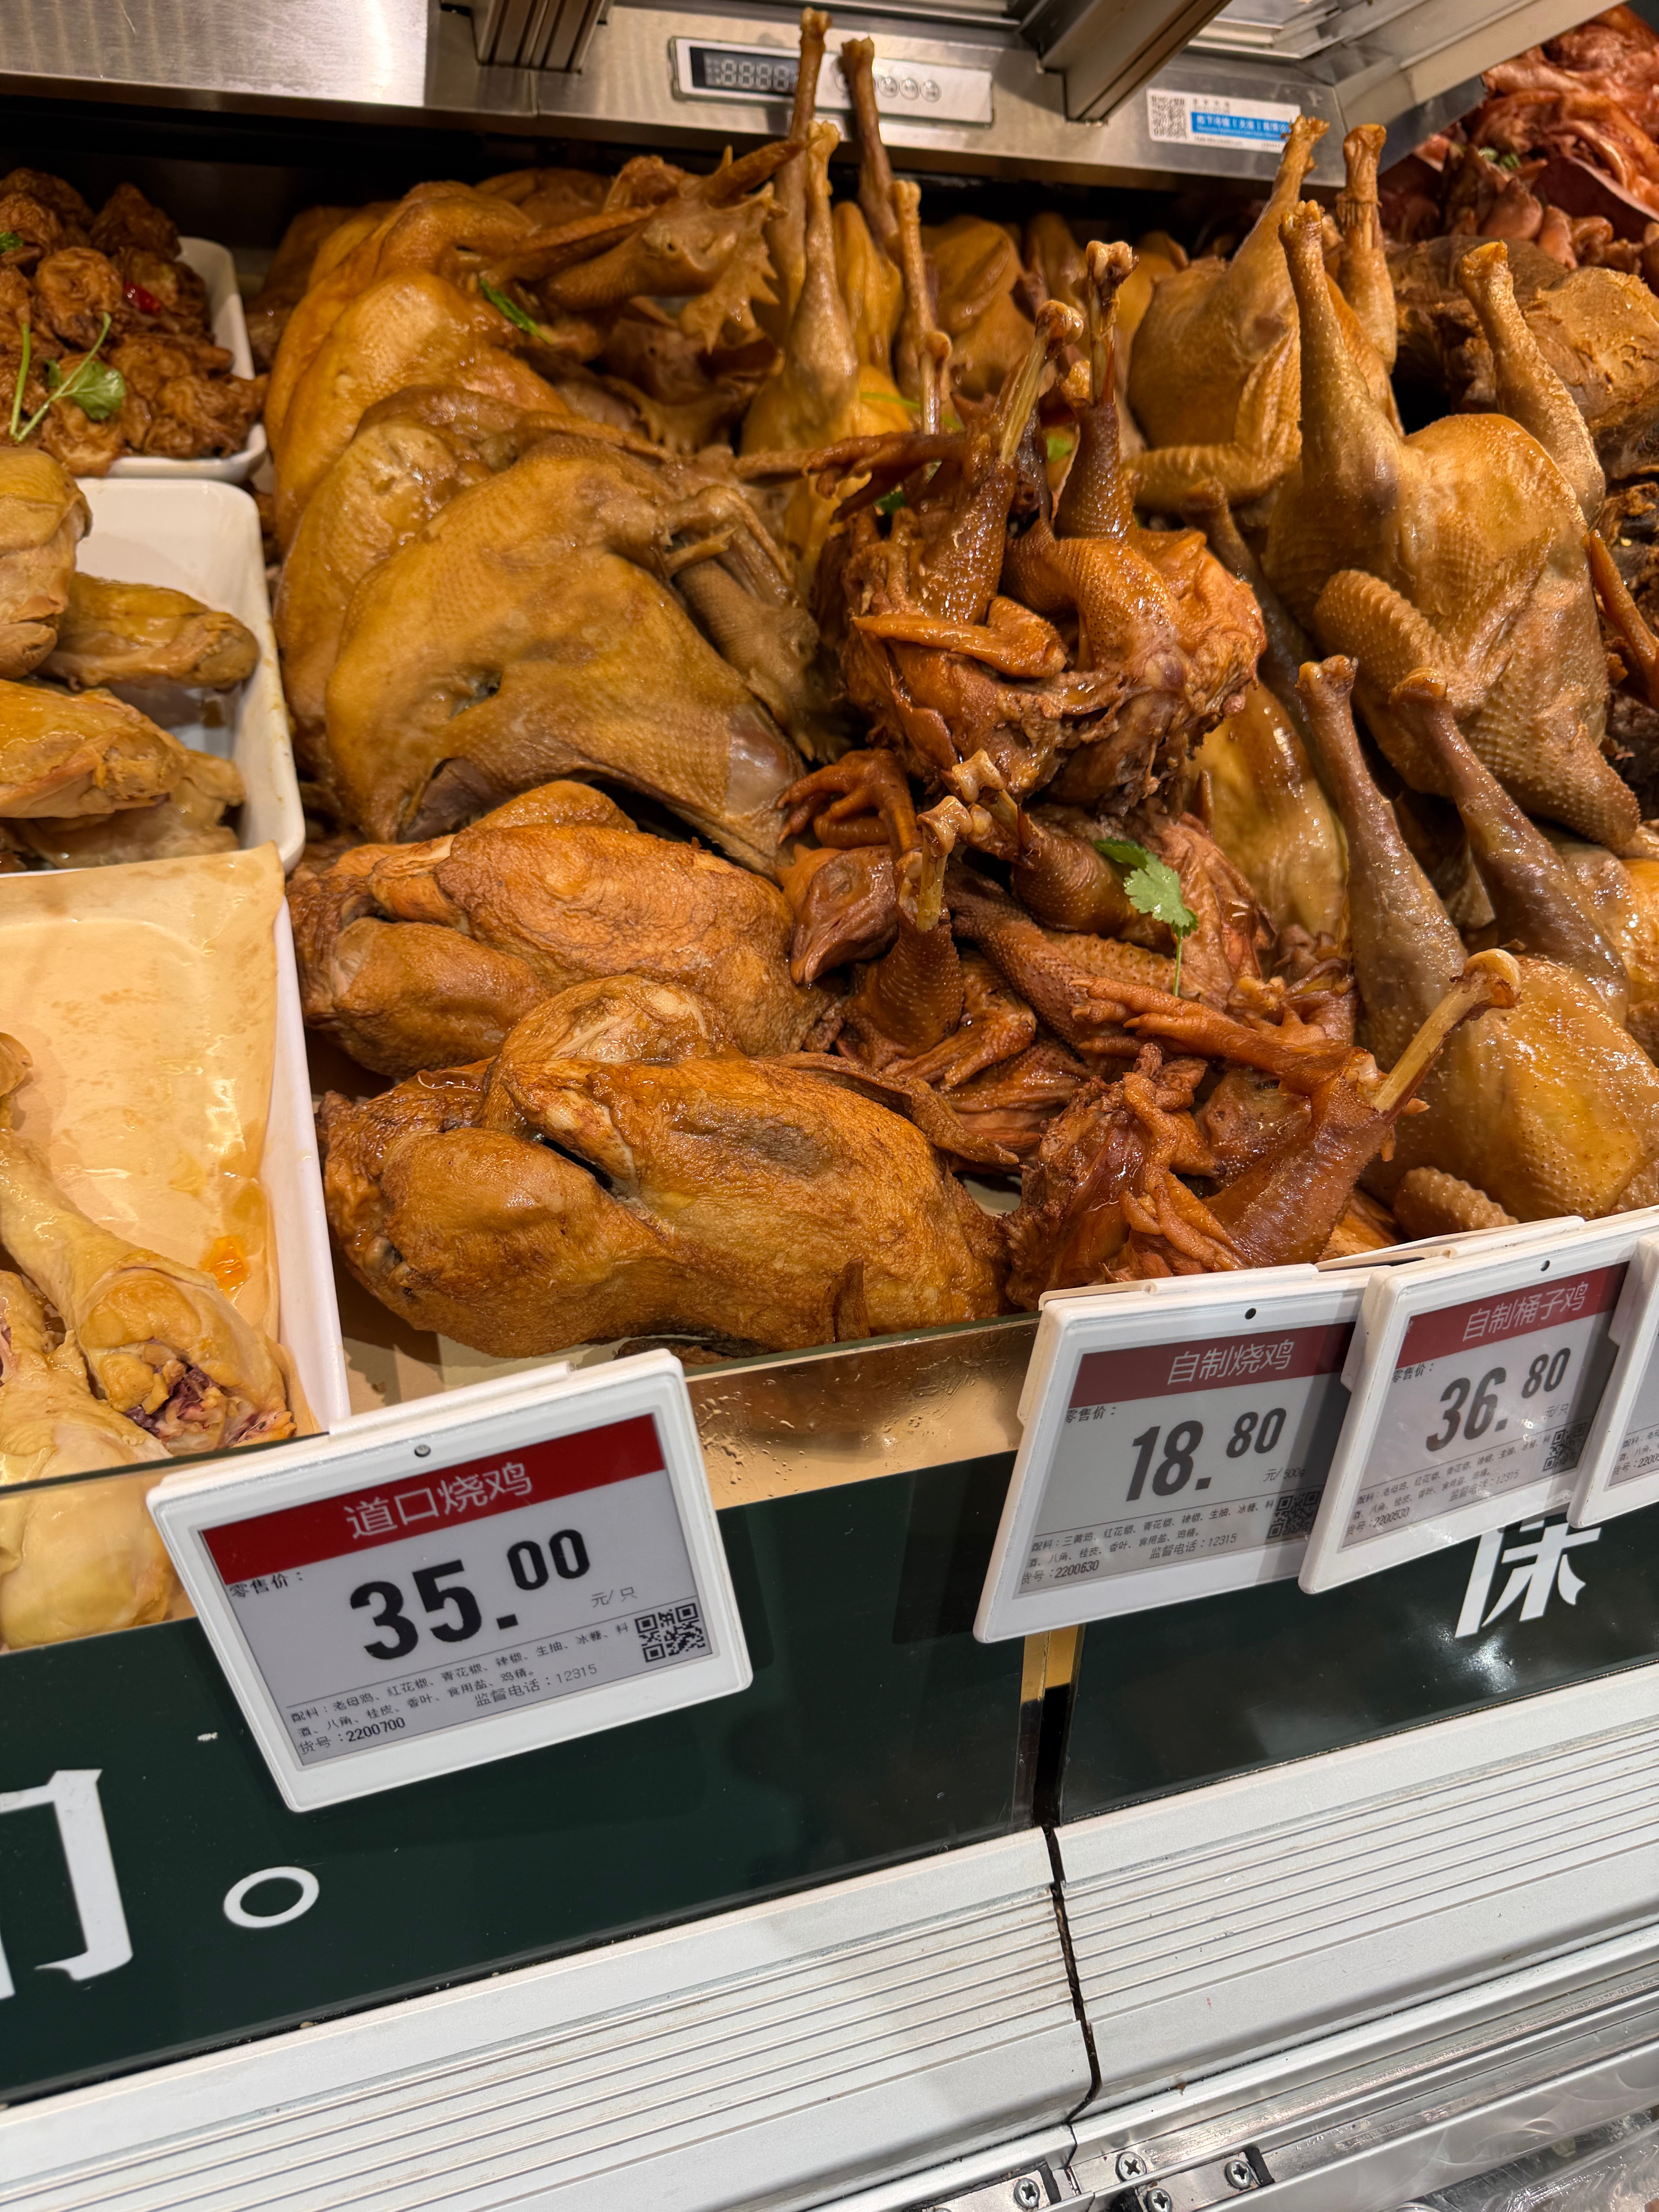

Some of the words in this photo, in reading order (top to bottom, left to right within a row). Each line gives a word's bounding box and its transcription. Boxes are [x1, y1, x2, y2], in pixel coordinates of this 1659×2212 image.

[1462, 1281, 1589, 1341] 自制桶子鸡
[1167, 1339, 1295, 1385] 自制烧鸡
[344, 1462, 534, 1540] 道口烧鸡
[474, 1663, 598, 1707] 监督电话：12315
